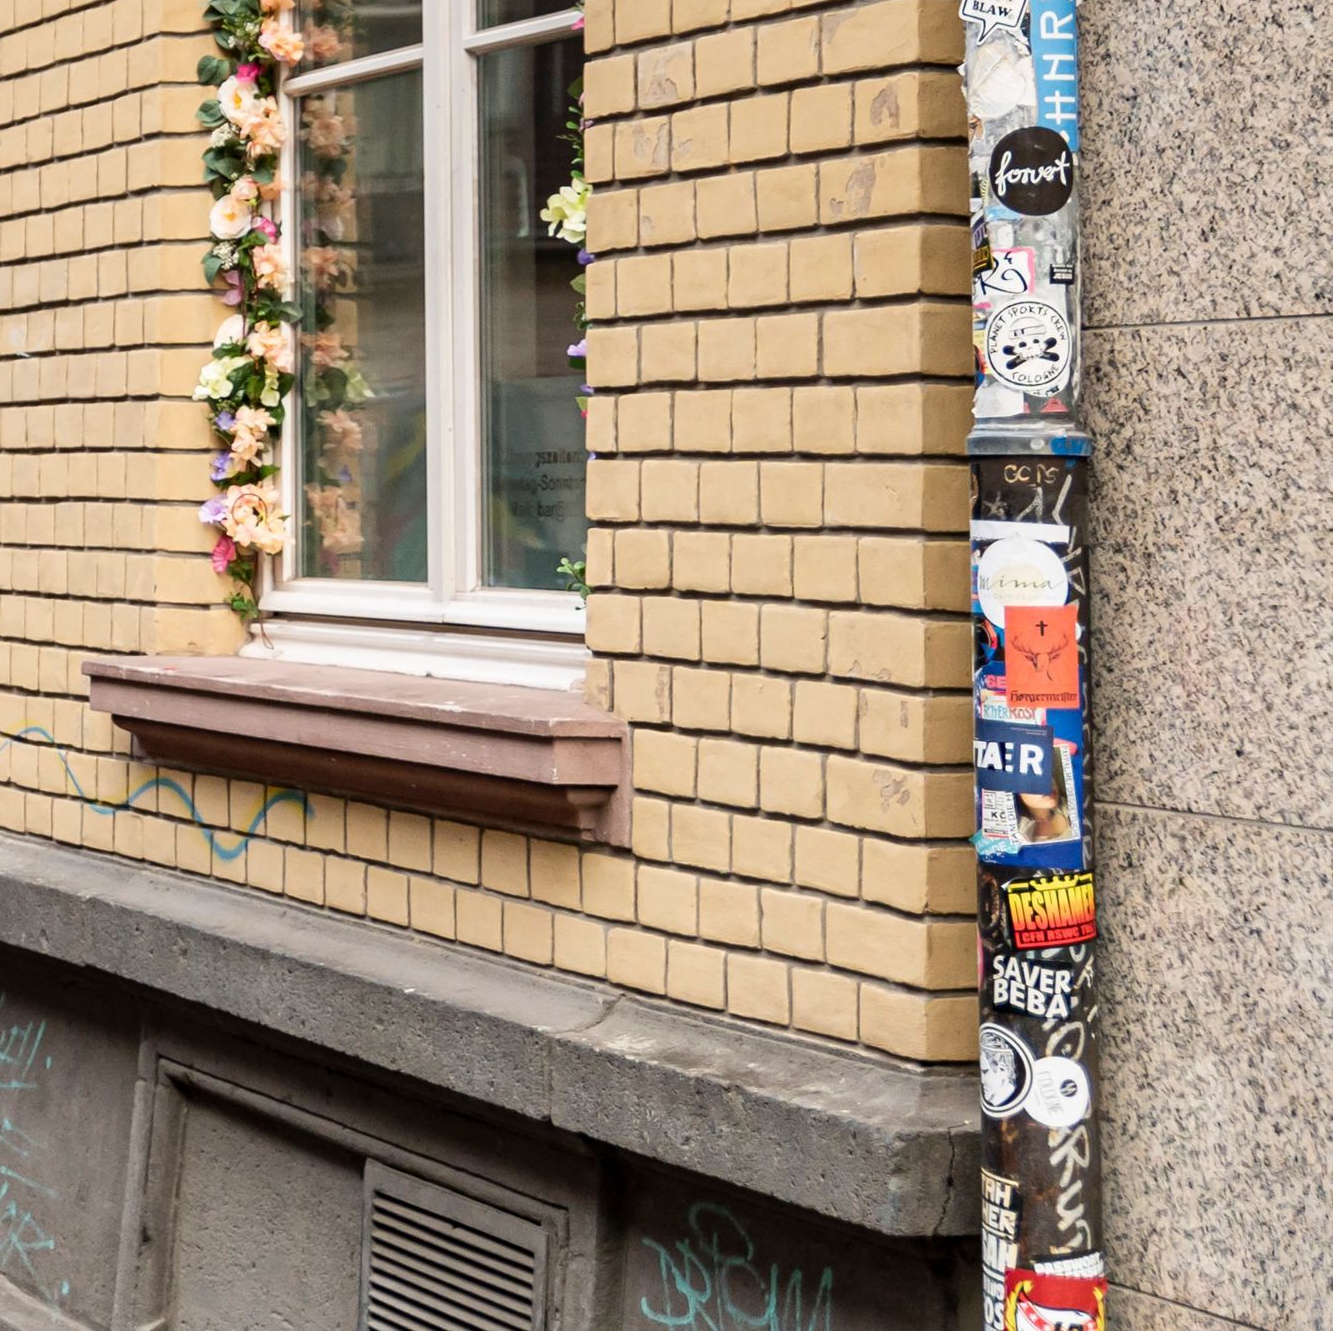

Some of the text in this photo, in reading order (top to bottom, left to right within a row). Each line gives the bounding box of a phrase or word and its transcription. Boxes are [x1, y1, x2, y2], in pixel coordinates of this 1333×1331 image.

[972, 0, 1012, 18] BLAW
[990, 316, 1006, 355] PLANET
[993, 954, 1071, 995] SAVER
[993, 978, 1069, 1019] BEBA
